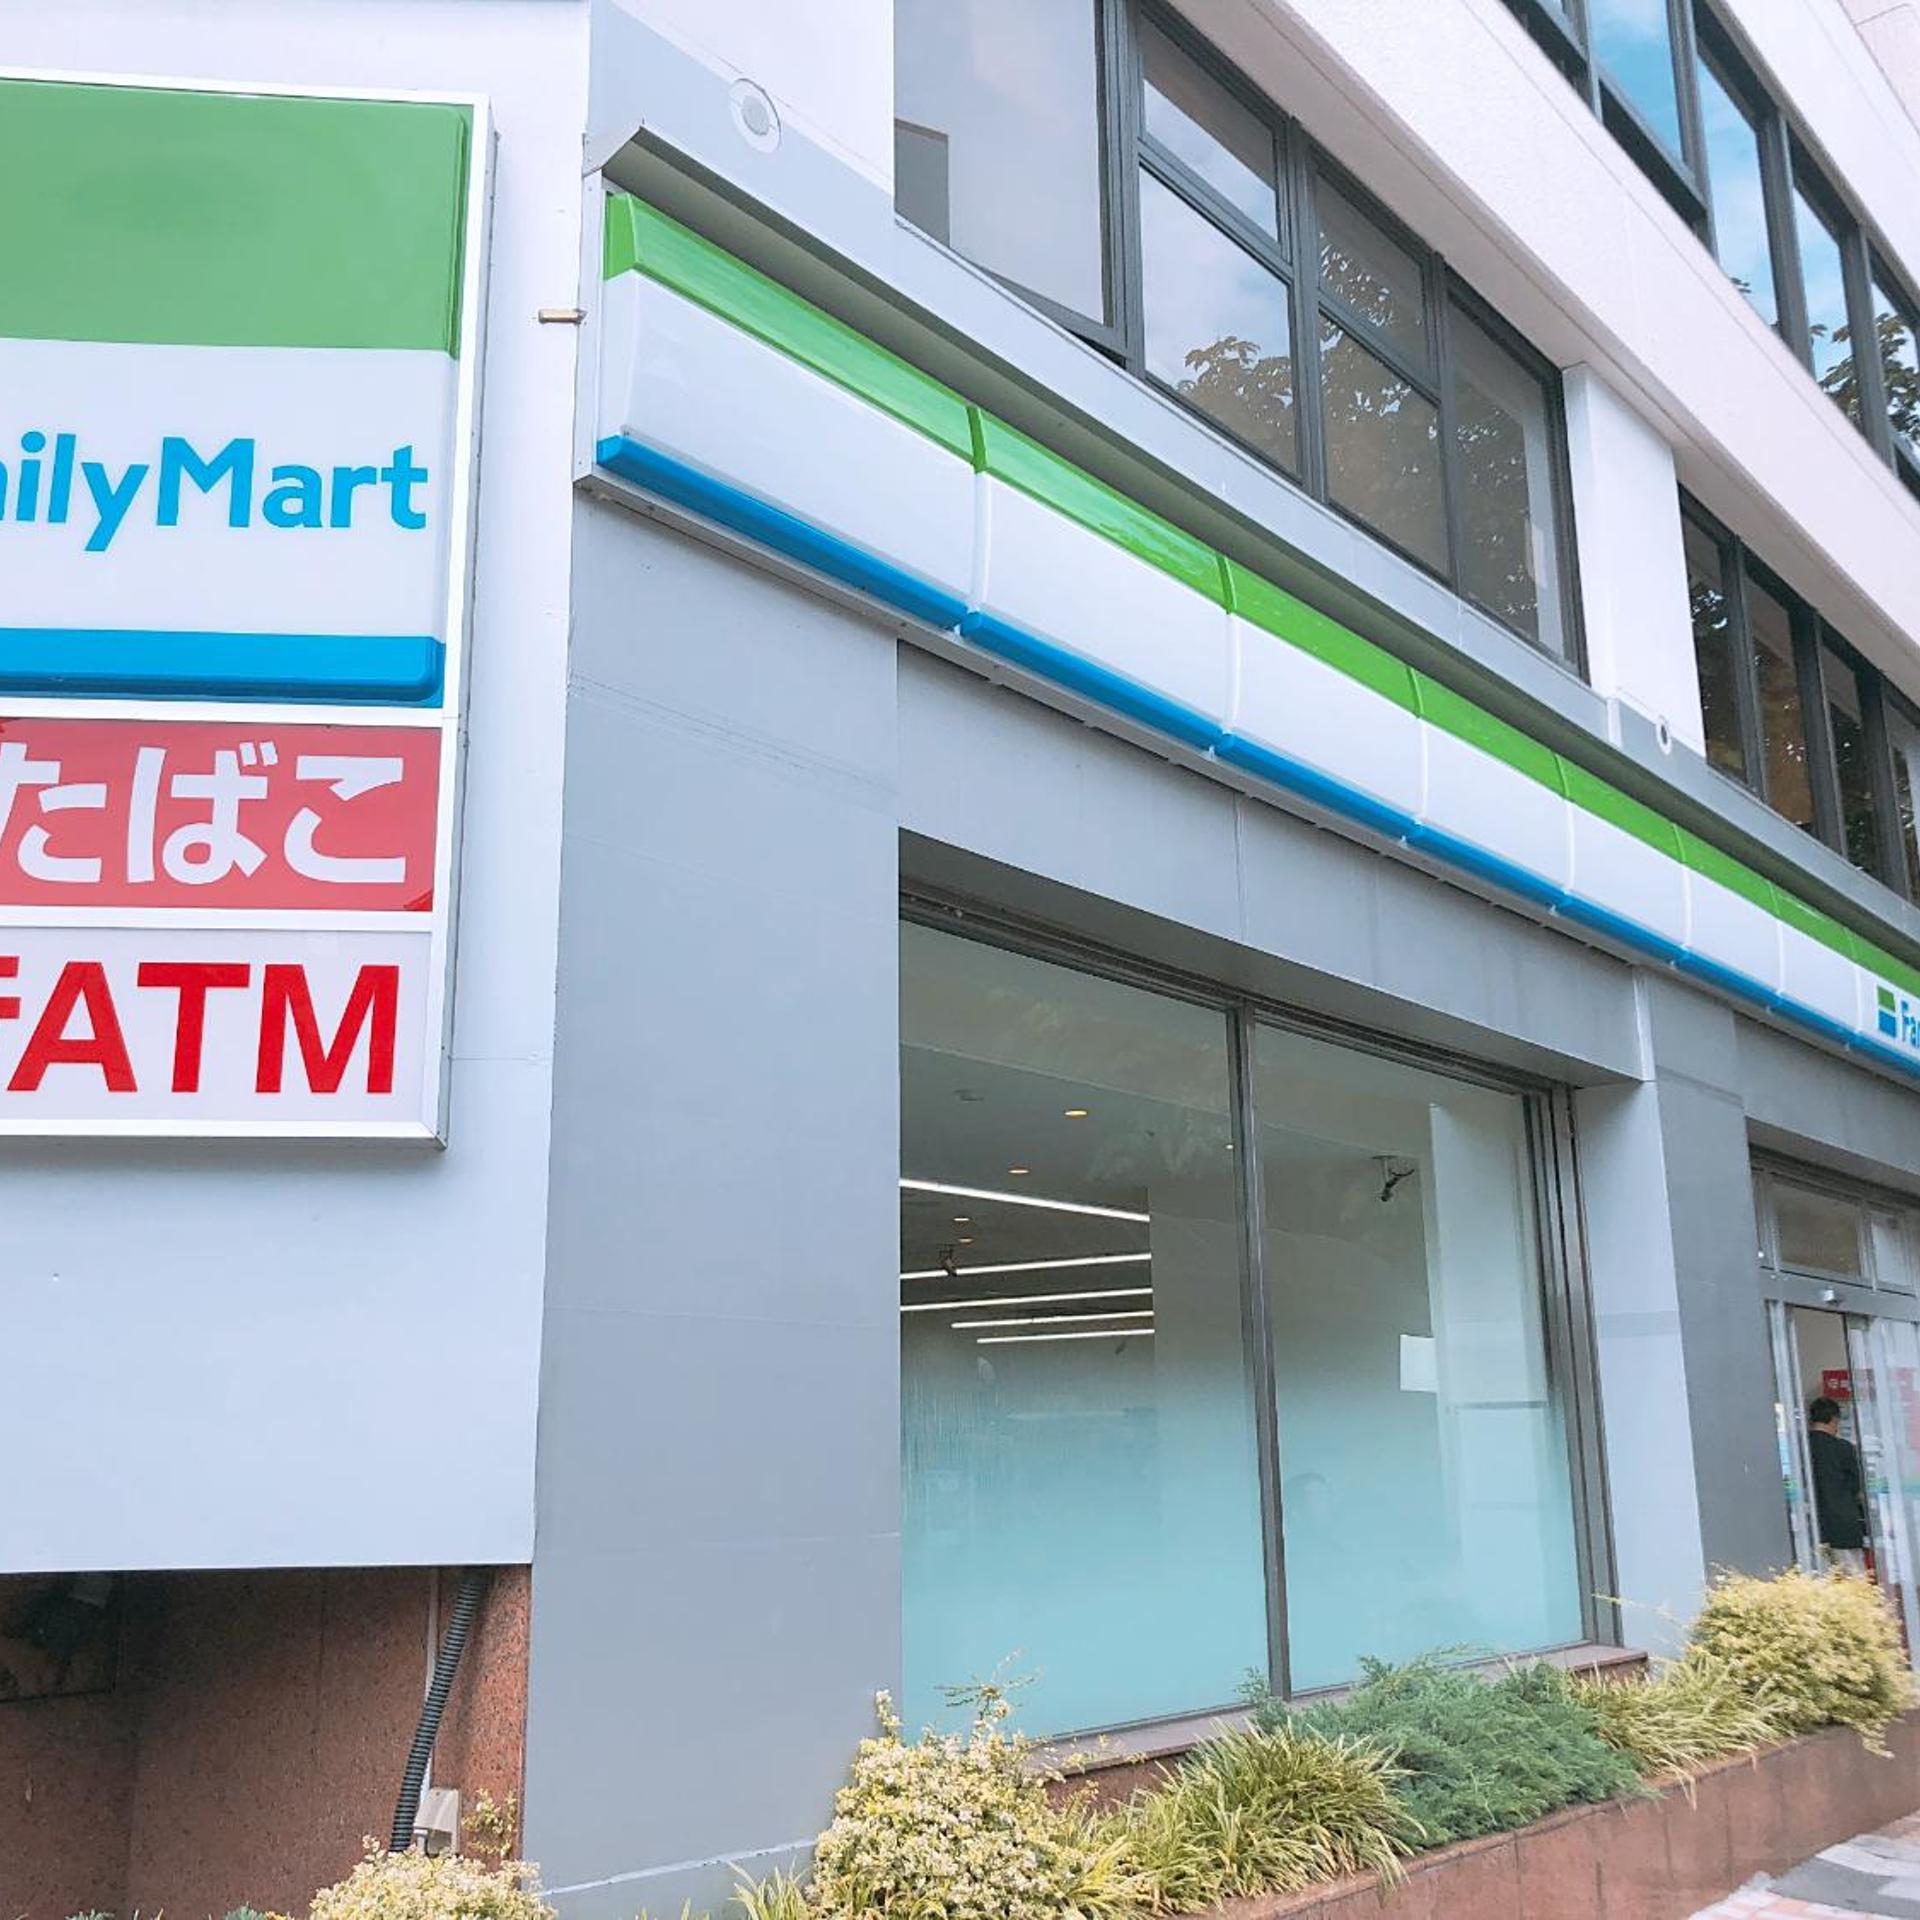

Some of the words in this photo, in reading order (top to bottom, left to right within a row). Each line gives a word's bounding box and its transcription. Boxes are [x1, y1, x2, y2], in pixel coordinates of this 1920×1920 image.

[0, 431, 428, 552] ilyMart
[0, 741, 406, 884] たばこ
[1901, 1000, 1920, 1048] Fa
